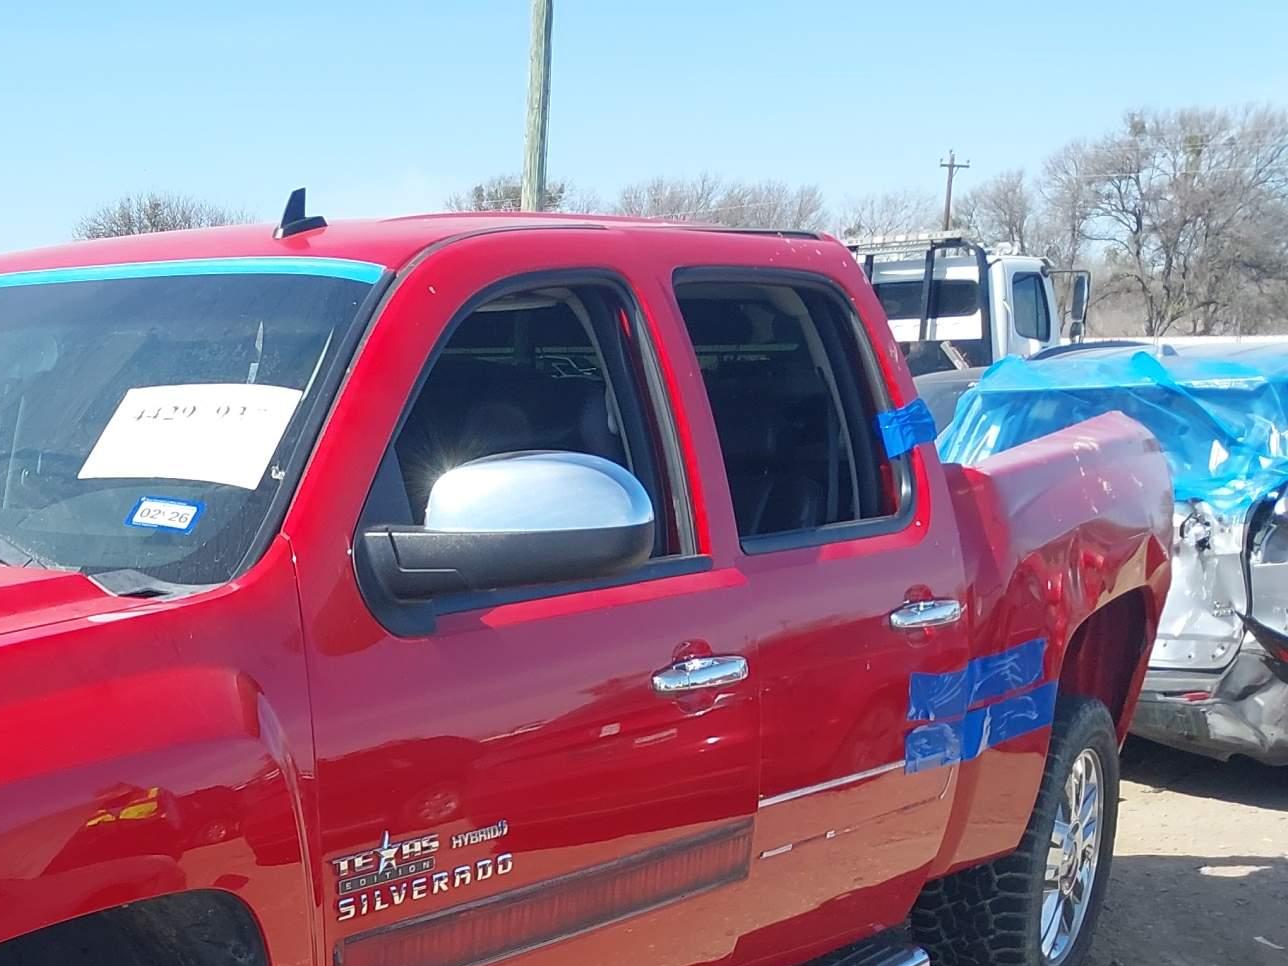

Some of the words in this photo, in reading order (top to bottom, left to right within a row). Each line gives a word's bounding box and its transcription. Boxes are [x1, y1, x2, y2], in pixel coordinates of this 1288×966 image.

[332, 831, 441, 876] TEXAS
[451, 820, 508, 850] HYBRID
[337, 854, 514, 922] SILVERADO
[344, 861, 433, 892] EDITION
